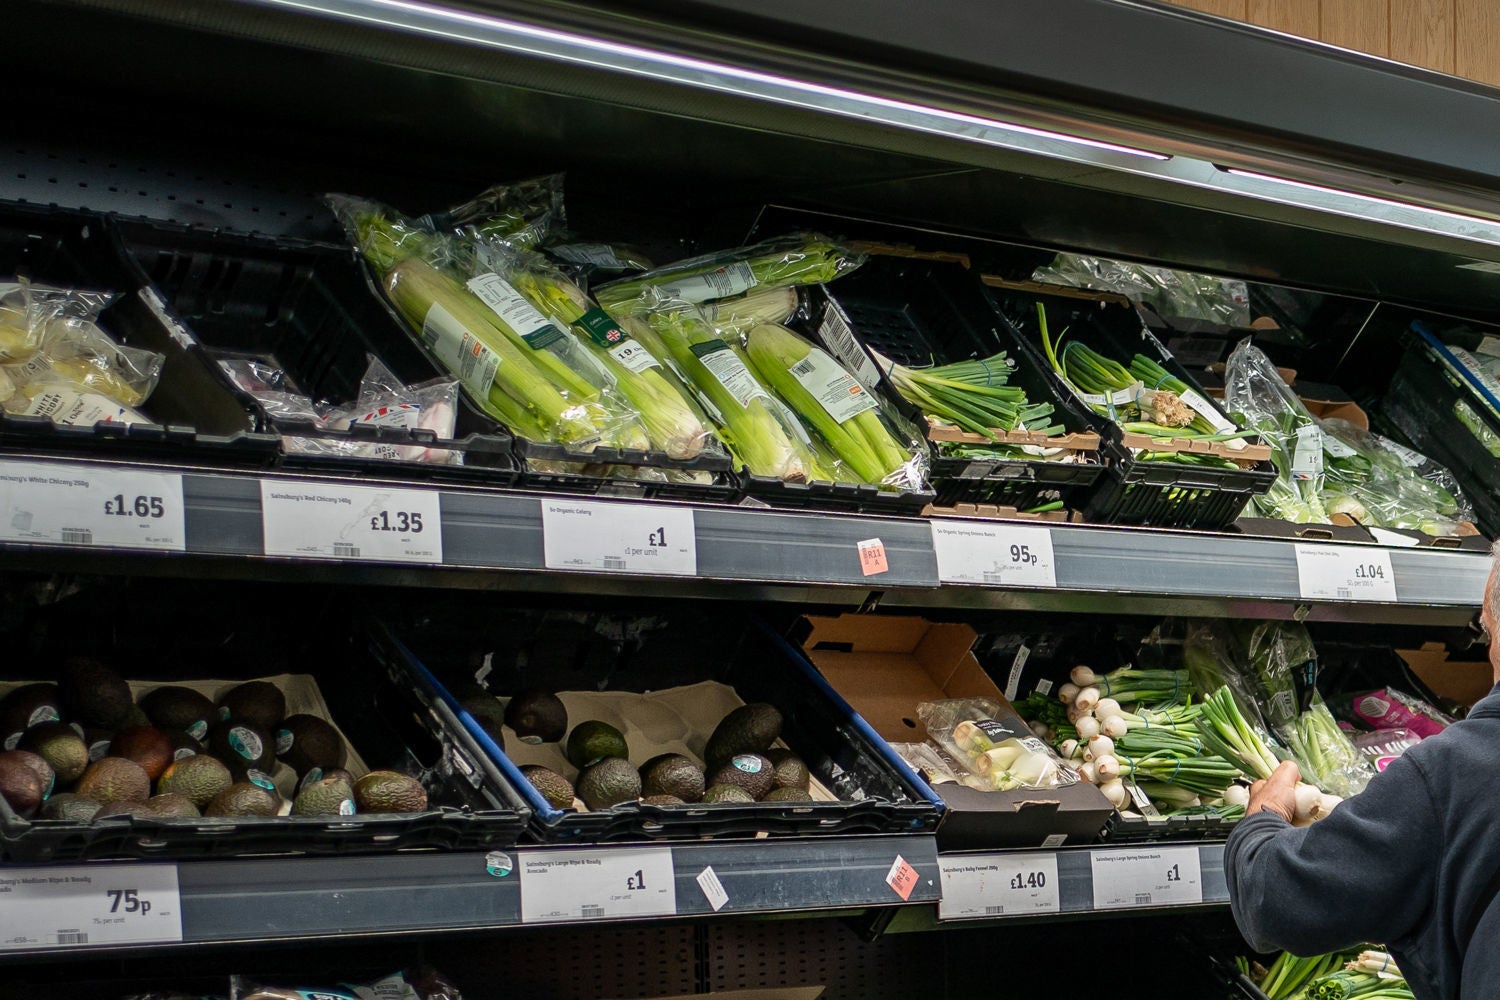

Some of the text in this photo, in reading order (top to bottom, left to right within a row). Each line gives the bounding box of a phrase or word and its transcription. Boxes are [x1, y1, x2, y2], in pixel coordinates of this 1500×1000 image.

[33, 394, 52, 415] WHITE
[29, 475, 48, 485] White
[49, 477, 73, 487] Chicory
[104, 494, 165, 518] £1.65
[271, 493, 304, 502] Sainsbury's
[304, 494, 316, 502] Red
[317, 495, 338, 504] Chicory
[556, 507, 575, 515] Organic
[575, 508, 592, 516] Celery
[371, 511, 423, 533] £1.35
[649, 527, 667, 547] £1
[632, 548, 643, 556] per
[643, 548, 658, 557] unit
[868, 548, 882, 559] R11
[1010, 544, 1037, 566] 95p
[1355, 564, 1384, 579] £1.04
[526, 860, 555, 869] Sainsbury's
[555, 859, 569, 867] Large
[569, 859, 580, 867] Ripe
[586, 858, 602, 867] Ready
[22, 876, 48, 885] Medium
[48, 876, 64, 885] Ripe
[71, 875, 91, 884] Ready
[627, 869, 646, 891] £1
[1010, 872, 1046, 889] £1.40
[1167, 863, 1181, 882] £1
[107, 889, 152, 916] 75p
